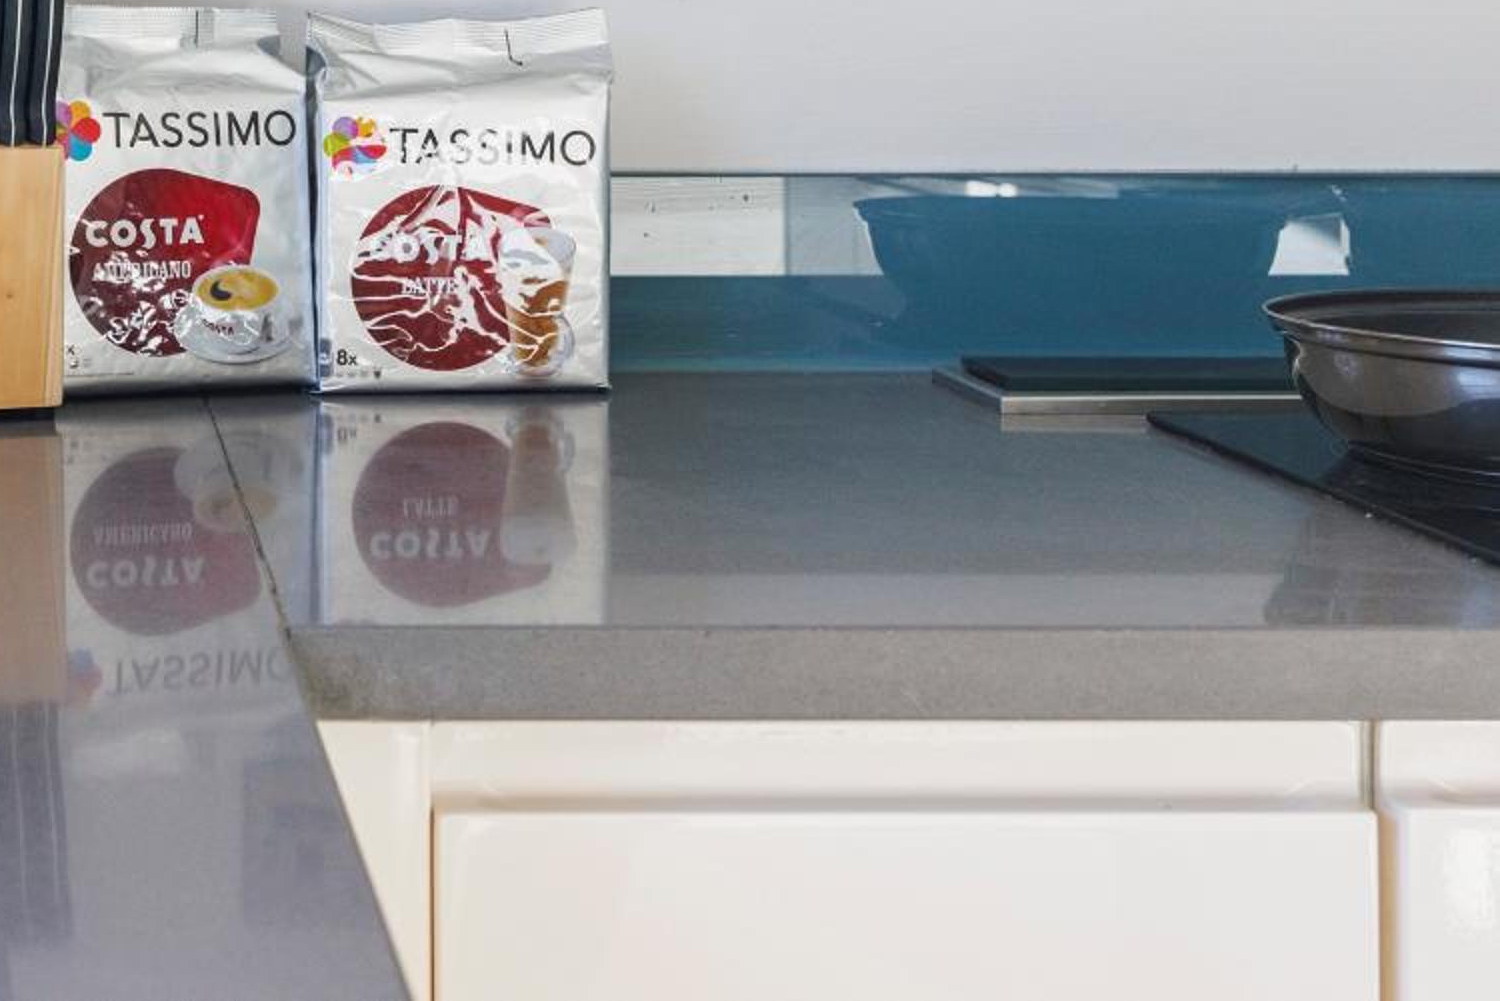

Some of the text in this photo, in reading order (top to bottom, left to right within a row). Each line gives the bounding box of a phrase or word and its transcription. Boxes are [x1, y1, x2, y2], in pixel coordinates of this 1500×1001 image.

[102, 110, 297, 149] TASSIMO
[390, 127, 597, 167] TASSIMO
[84, 216, 204, 250] COSTA
[337, 348, 357, 366] 8x
